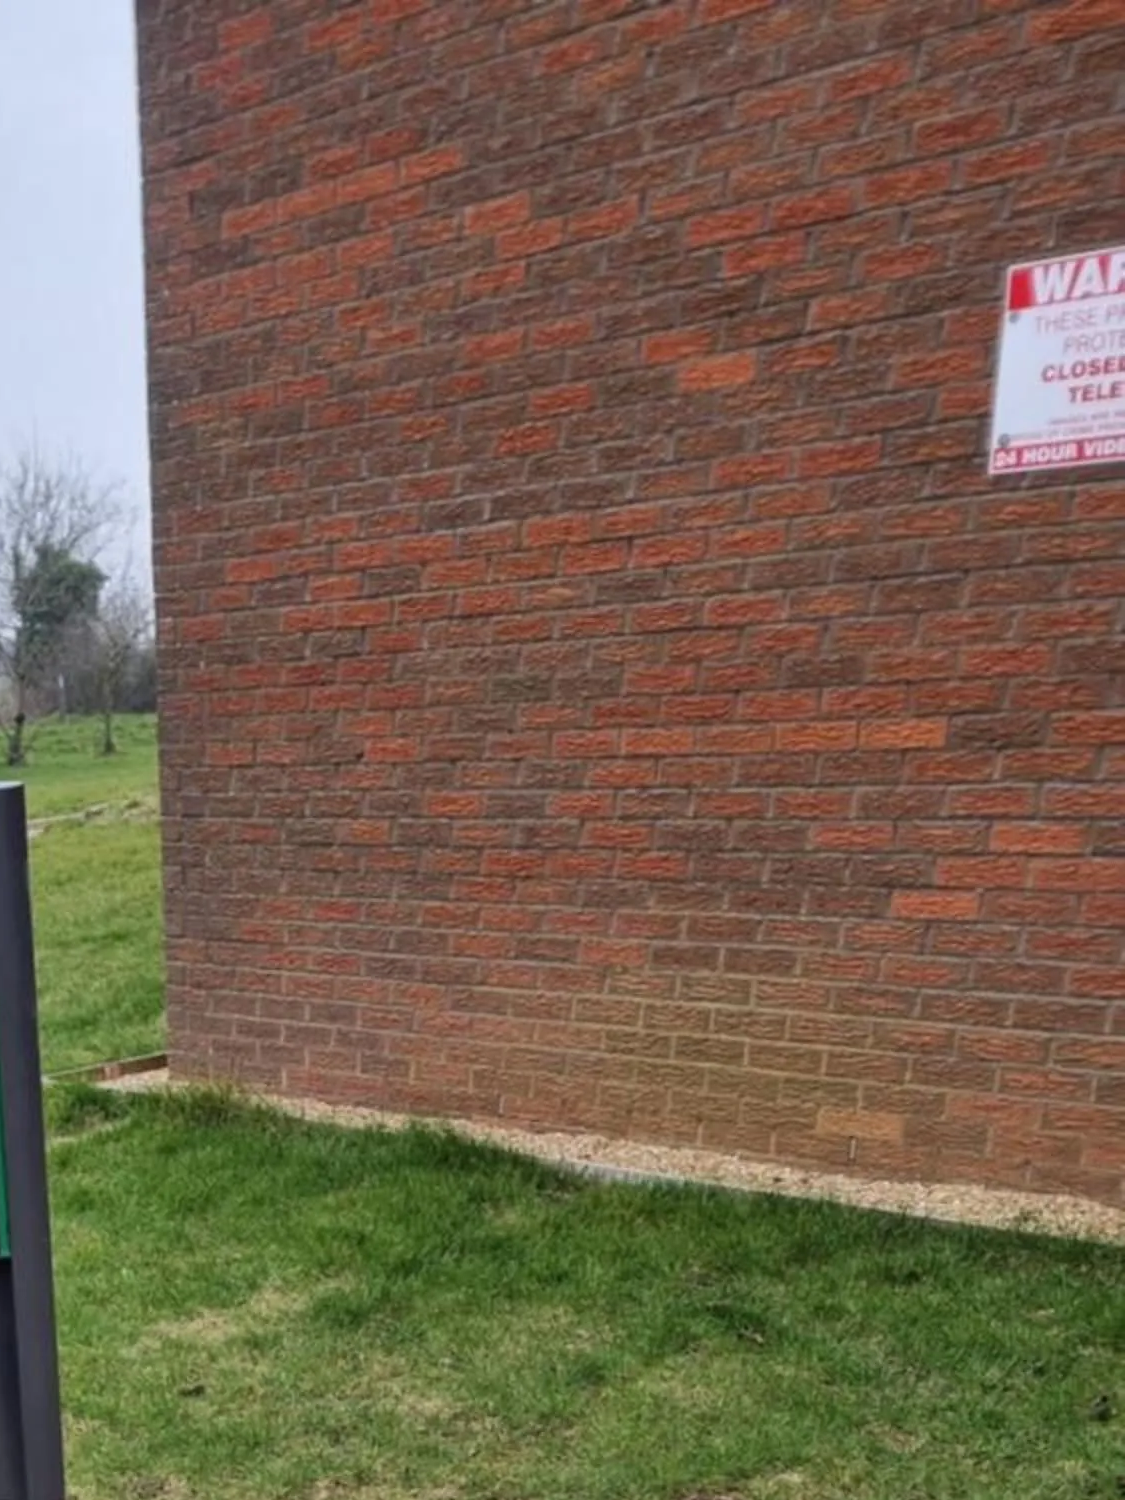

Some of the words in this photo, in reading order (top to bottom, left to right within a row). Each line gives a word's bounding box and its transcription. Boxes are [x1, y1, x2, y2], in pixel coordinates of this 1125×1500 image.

[1035, 306, 1097, 335] THESE
[994, 447, 1017, 467] 24
[1022, 441, 1078, 464] HOUR
